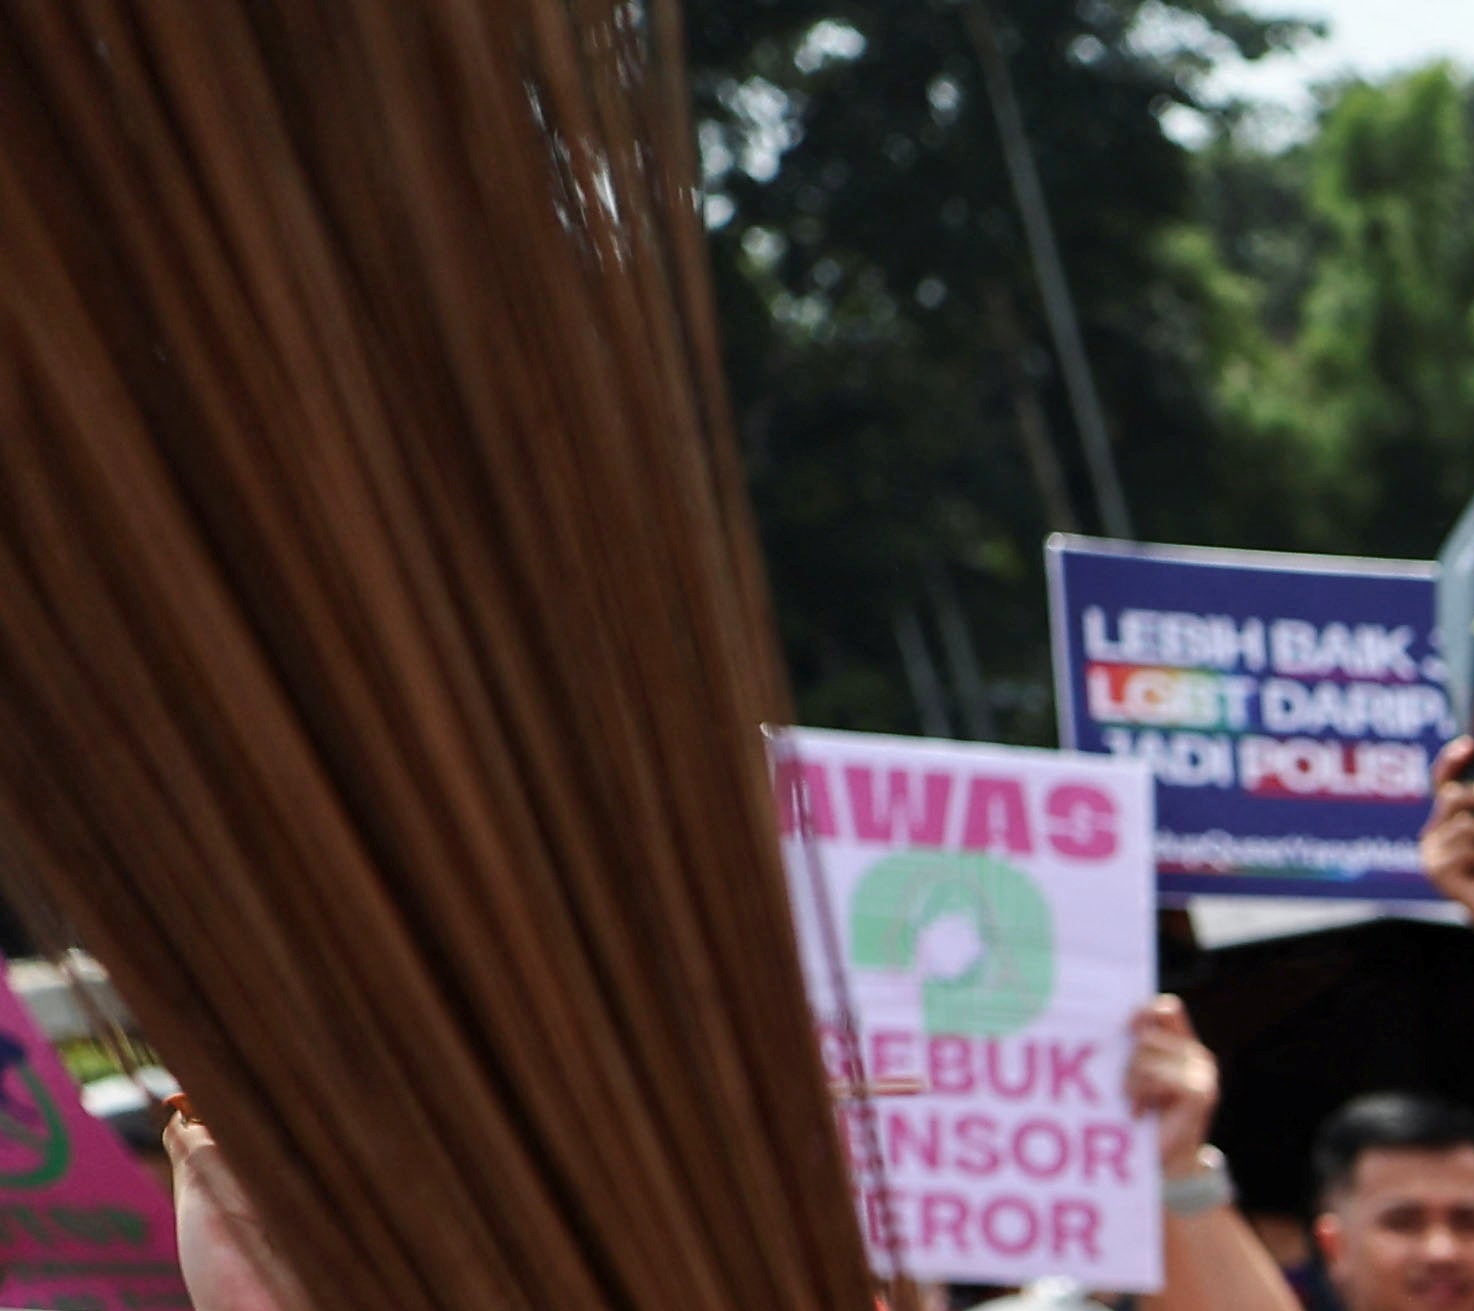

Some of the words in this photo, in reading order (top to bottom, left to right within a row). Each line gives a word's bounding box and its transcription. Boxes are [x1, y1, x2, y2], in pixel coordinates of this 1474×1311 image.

[1081, 604, 1268, 674] LEBIH
[1269, 616, 1420, 683] BAIK
[1086, 663, 1258, 730] LGBT
[1104, 726, 1236, 789] JADI
[1237, 734, 1433, 800] POLISI
[780, 762, 1119, 865] AWAS
